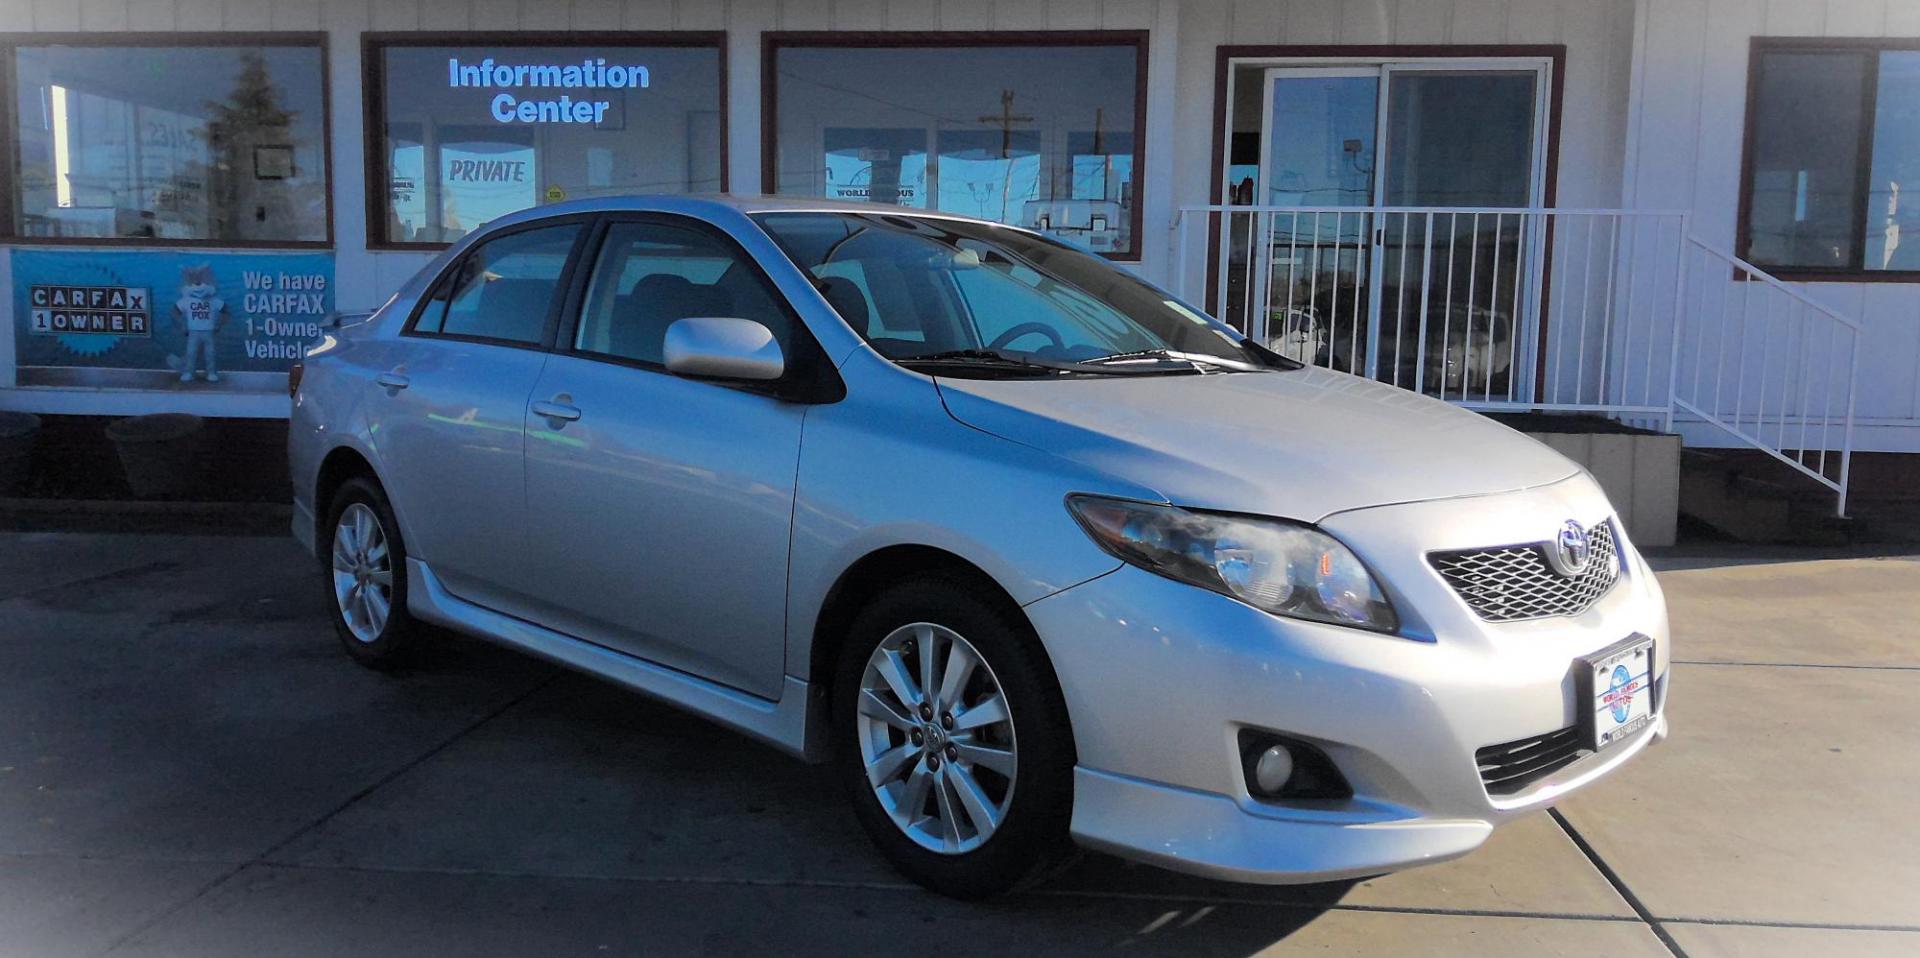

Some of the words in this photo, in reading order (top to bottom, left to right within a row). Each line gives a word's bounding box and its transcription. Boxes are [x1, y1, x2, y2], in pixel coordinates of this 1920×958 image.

[449, 58, 650, 88] Information
[491, 93, 610, 123] Center
[450, 159, 526, 182] PRIVATE
[243, 271, 273, 290] We
[279, 271, 326, 290] have
[33, 289, 142, 309] CARFAX
[190, 302, 210, 311] CAR
[244, 293, 325, 314] CARFAX
[191, 312, 210, 320] FOX
